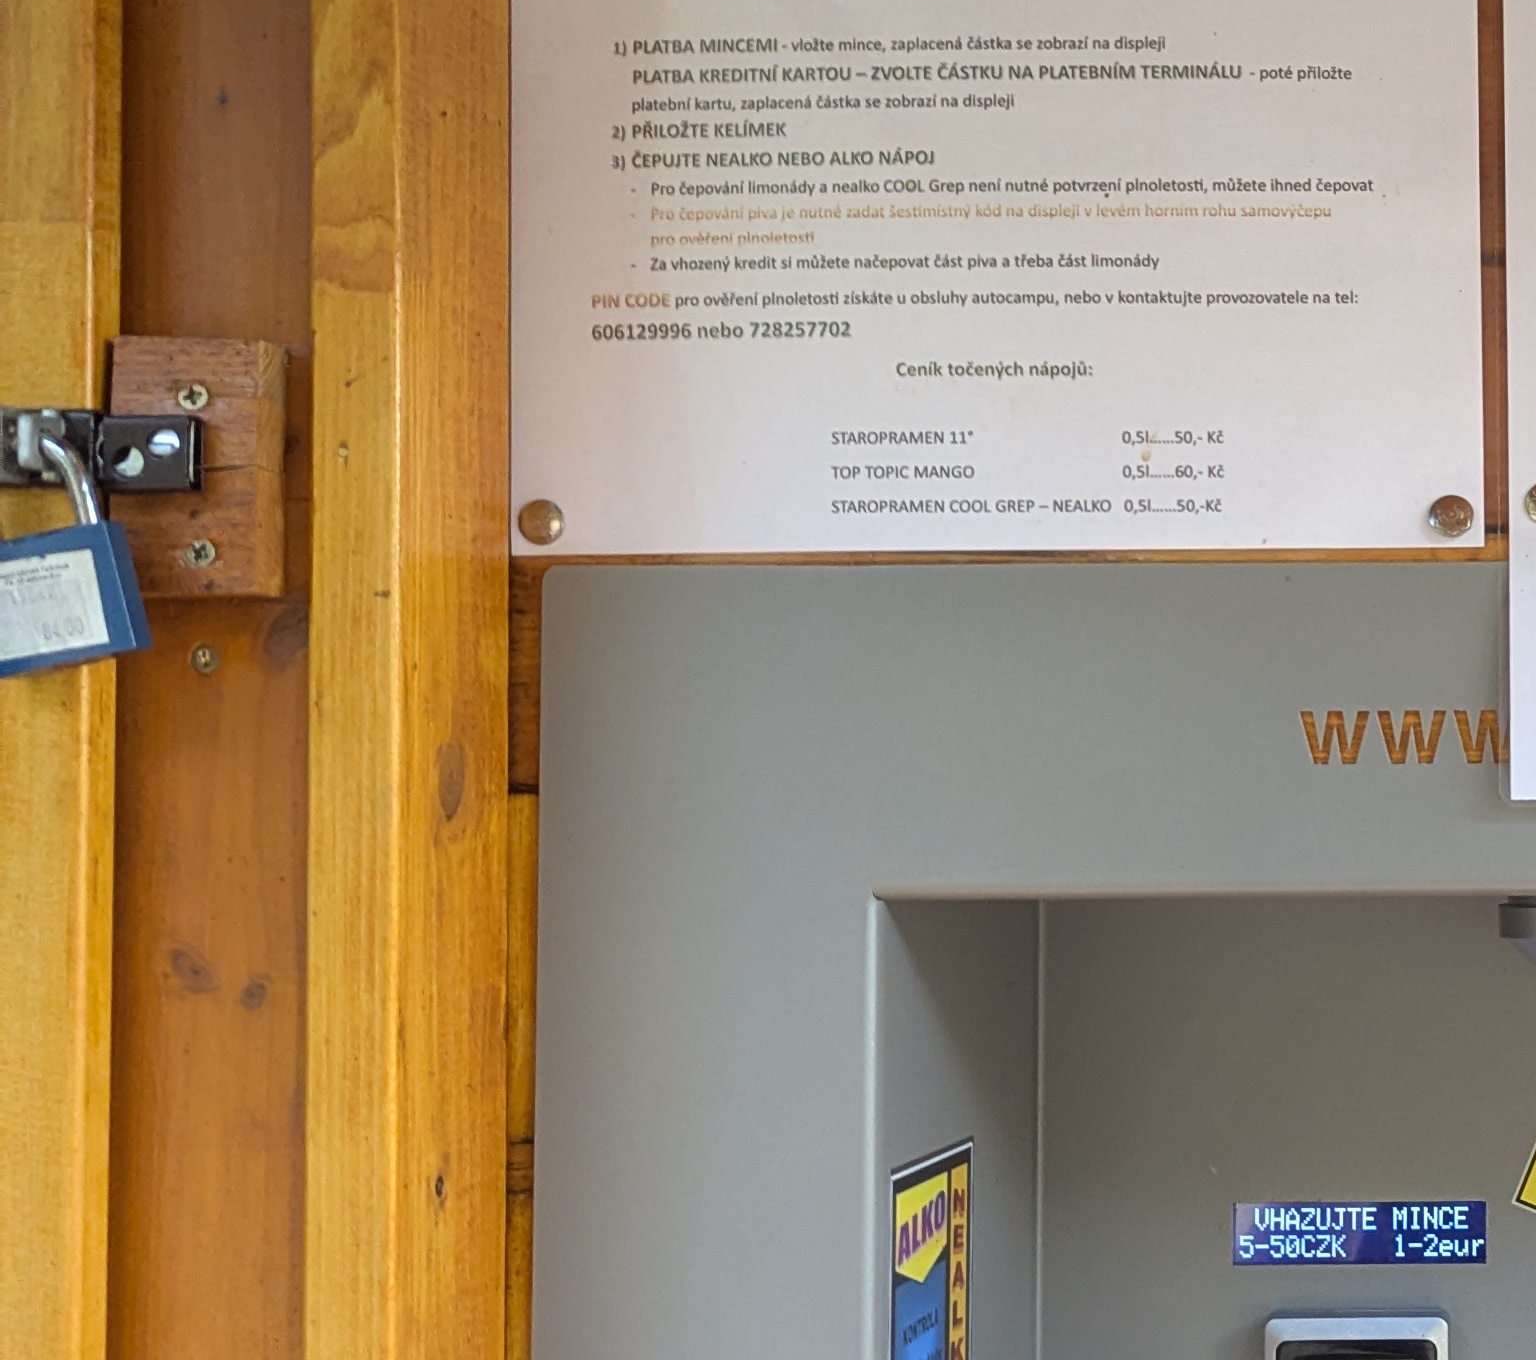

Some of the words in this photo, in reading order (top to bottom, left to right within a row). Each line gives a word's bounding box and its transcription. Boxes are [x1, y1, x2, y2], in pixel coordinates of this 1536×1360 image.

[613, 39, 628, 59] 1)
[632, 38, 695, 56] PLATBA
[699, 37, 778, 54] MINCEMI
[790, 37, 835, 52] vložte
[838, 37, 886, 53] mince,
[890, 36, 963, 54] zaplacená
[966, 35, 1013, 51] částka
[1015, 39, 1033, 51] se
[1036, 35, 1089, 50] zobrazí
[1092, 39, 1110, 50] na
[1113, 35, 1166, 53] displeji
[632, 68, 695, 85] PLATBA
[699, 64, 779, 84] KREDITNÍ
[782, 66, 852, 82] KARTOU
[870, 65, 933, 81] ZVOLTE
[937, 62, 1003, 81] ČÁSTKU
[1008, 64, 1034, 80] NA
[1038, 61, 1136, 80] PLATEBNÍM
[1140, 61, 1242, 80] TERMINÁLU
[1259, 65, 1293, 82] poté
[1297, 65, 1353, 83] přiložte
[611, 124, 627, 143] 2)
[631, 119, 709, 140] PŘILOŽTE
[714, 119, 787, 138] KELÍMEK
[611, 154, 626, 172] 3)
[630, 149, 701, 170] ČEPUJTE
[706, 152, 773, 168] NEALKO
[777, 151, 825, 167] NEBO
[829, 150, 874, 166] ALKO
[878, 147, 935, 166] NÁPOJ
[650, 181, 676, 197] Pro
[678, 179, 745, 199] čepování
[748, 179, 816, 197] limonády
[819, 183, 828, 194] a
[832, 179, 880, 194] nealko
[883, 178, 925, 194] COOL
[928, 178, 965, 196] Grep
[968, 177, 1002, 193] není
[1005, 178, 1049, 193] nutné
[1052, 177, 1122, 195] potvrzení
[1125, 177, 1208, 195] plnoletosti,
[1212, 177, 1267, 192] můžete
[1270, 177, 1312, 192] ihned
[1315, 177, 1374, 195] čepovat
[590, 293, 621, 310] PIN
[624, 292, 671, 310] CODE
[674, 295, 700, 311] pro
[703, 292, 758, 307] ověření
[762, 291, 839, 310] plnoletosti
[843, 290, 893, 306] získáte
[896, 294, 906, 305] u
[910, 289, 968, 307] obsluhy
[971, 291, 1060, 307] autocampu,
[1063, 289, 1102, 304] nebo
[1104, 293, 1114, 304] v
[1117, 289, 1203, 307] kontaktujte
[1206, 289, 1309, 307] provozovatele
[1312, 293, 1331, 304] na
[1334, 290, 1359, 305] tel:
[591, 322, 692, 342] 606129996
[697, 321, 744, 339] nebo
[749, 321, 851, 338] 728257702
[895, 361, 943, 377] Ceník
[947, 361, 1024, 380] točených
[1029, 360, 1093, 381] nápojů:
[831, 430, 945, 446] STAROPRAMEN
[950, 429, 974, 445] 11°
[1207, 429, 1224, 444] Kč
[831, 465, 861, 480] TOP
[864, 465, 910, 480] TOPIC
[913, 465, 975, 479] MANGO
[1207, 464, 1225, 479] Kč
[831, 499, 945, 514] STAROPRAMEN
[949, 499, 991, 514] COOL
[995, 499, 1036, 513] GREP
[1052, 499, 1112, 513] NEALKO
[897, 1190, 947, 1268] ALKO
[1254, 1207, 1378, 1231] VHAZUJTE
[1392, 1206, 1469, 1231] MINCE
[1239, 1235, 1347, 1259] 5-50CZK
[1395, 1233, 1485, 1258] 1-2eur
